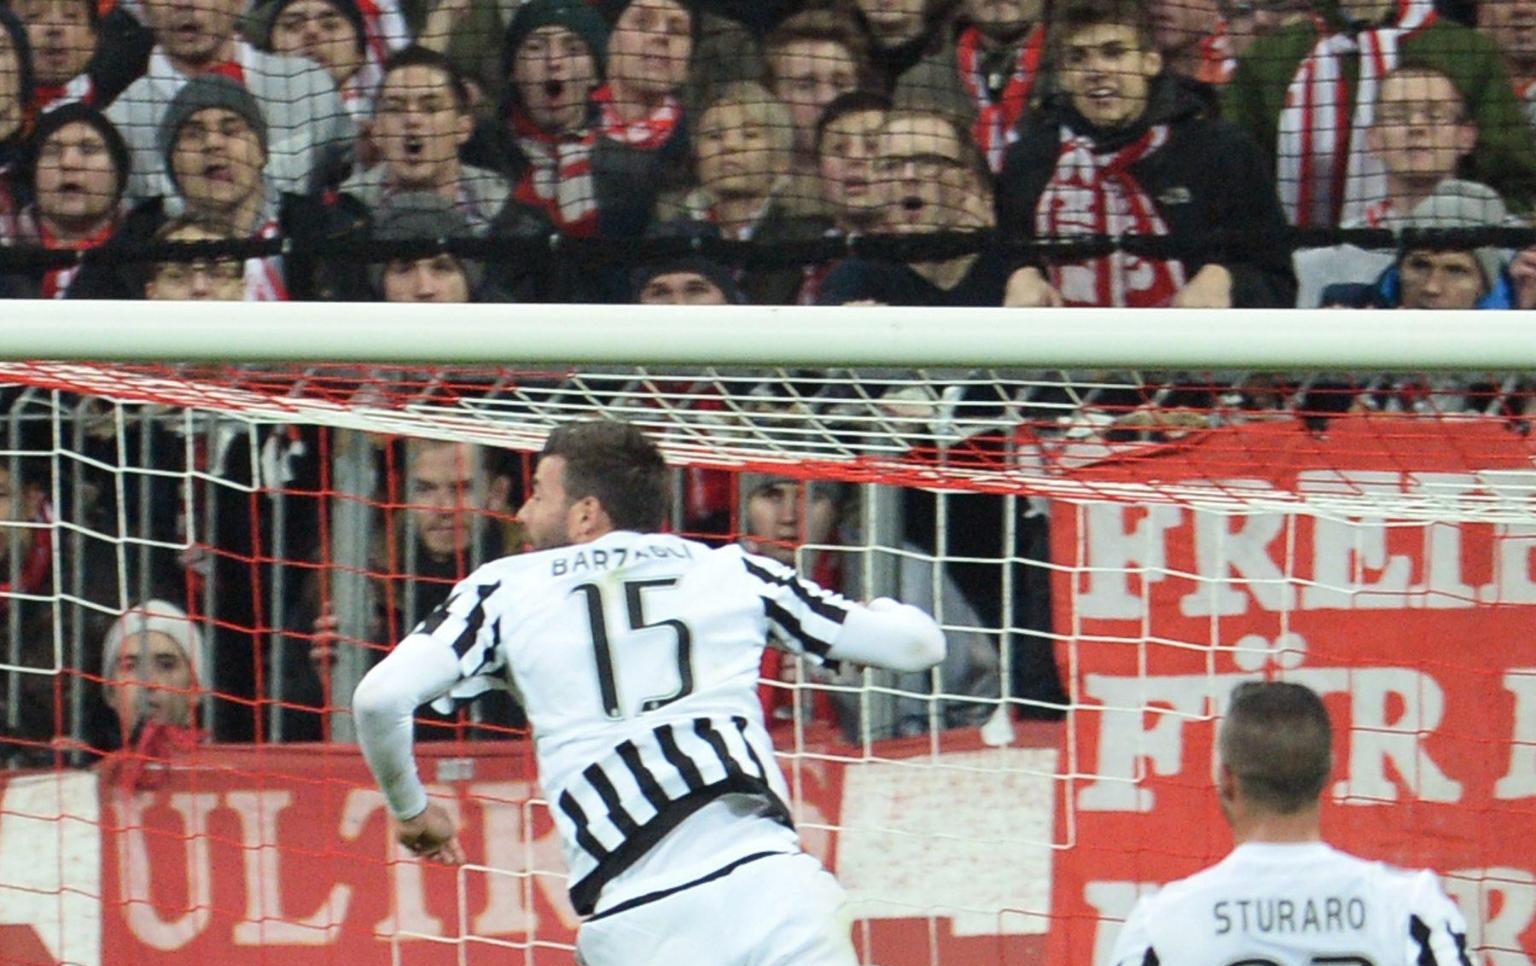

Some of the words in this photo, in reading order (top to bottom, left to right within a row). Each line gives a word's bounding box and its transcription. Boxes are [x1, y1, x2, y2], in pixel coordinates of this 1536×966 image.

[572, 575, 697, 721] 15
[1078, 632, 1464, 814] FR
[111, 782, 830, 952] ULTR
[1213, 897, 1366, 935] STURARO
